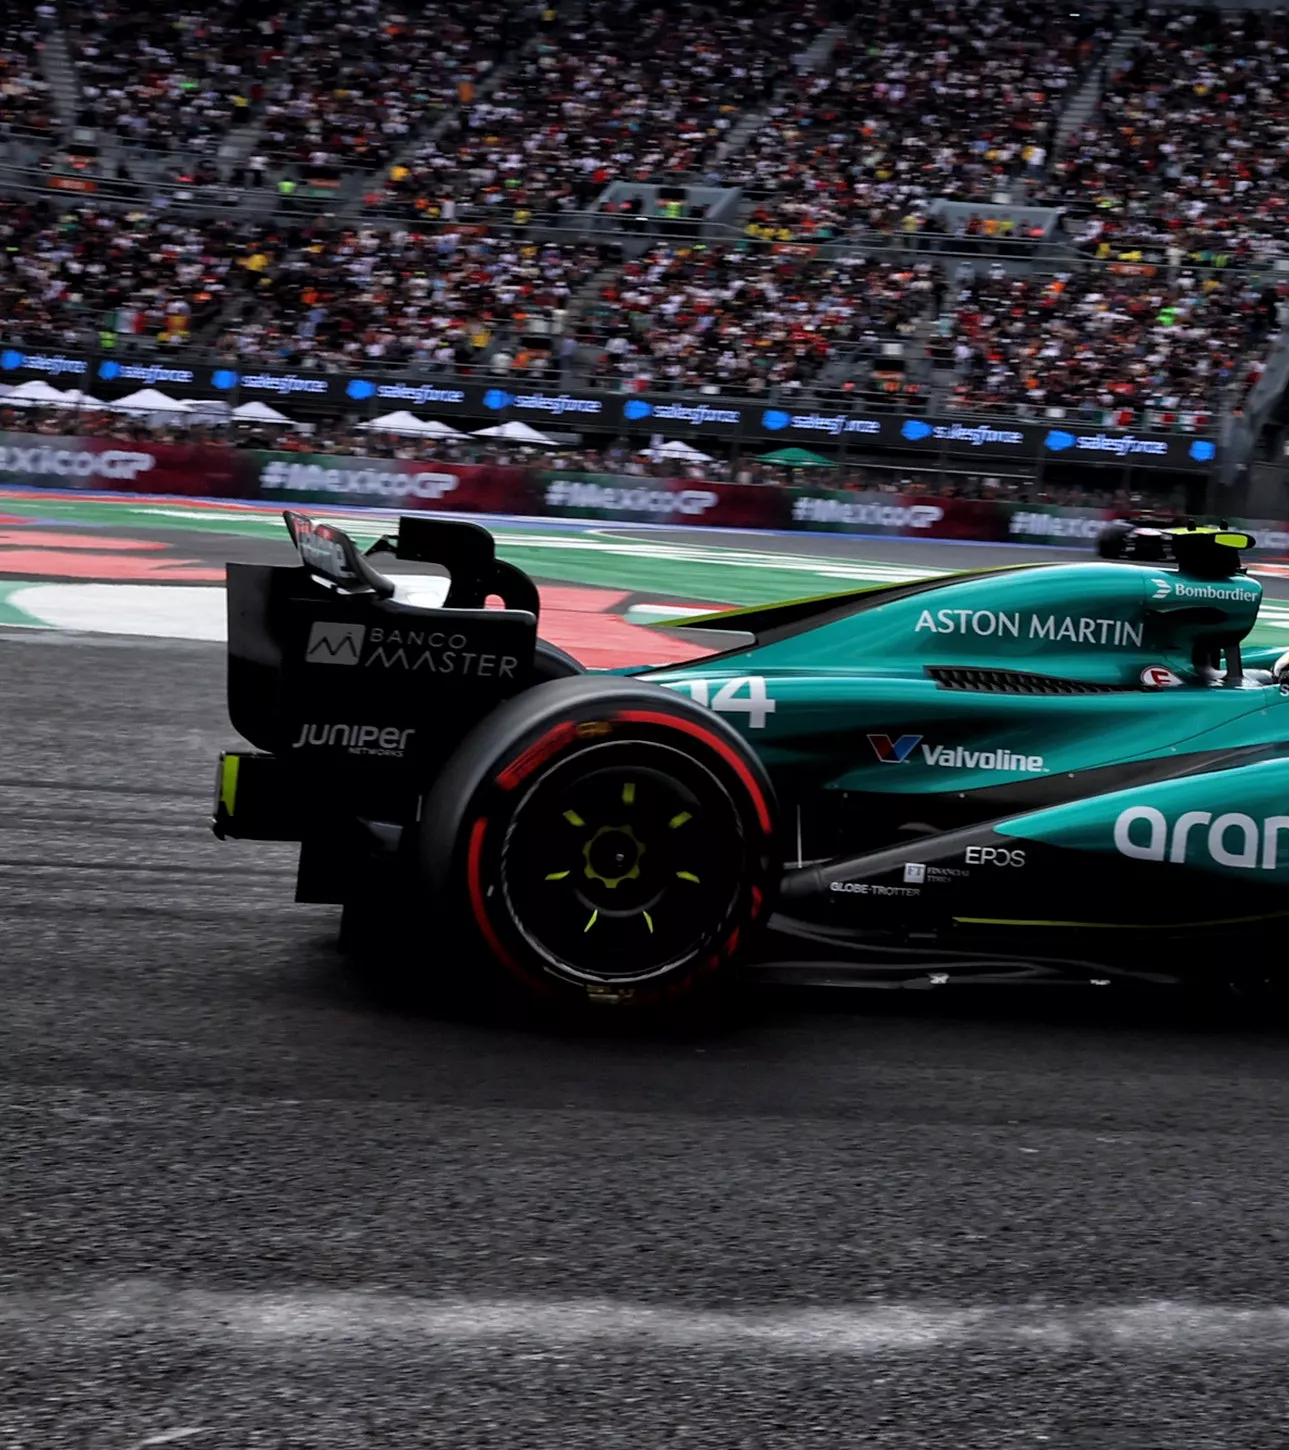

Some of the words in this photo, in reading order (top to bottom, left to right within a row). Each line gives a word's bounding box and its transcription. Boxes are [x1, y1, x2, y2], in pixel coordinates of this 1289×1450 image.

[241, 374, 328, 394] salesforce
[376, 383, 465, 404] salesforce
[513, 394, 602, 414] salesforce
[652, 403, 741, 425] salesforce
[1075, 434, 1168, 455] salesforce
[259, 461, 460, 499] #MexicoGP
[545, 480, 719, 515] #MexicoGP
[1175, 584, 1257, 602] Bombardier
[369, 627, 467, 649] BANCO
[915, 609, 1019, 637] ASTON
[1029, 614, 1144, 647] MARTIN
[365, 647, 518, 678] MASTER
[921, 744, 1044, 772] Valvoline
[830, 881, 921, 896] GLOBE-TROTTER
